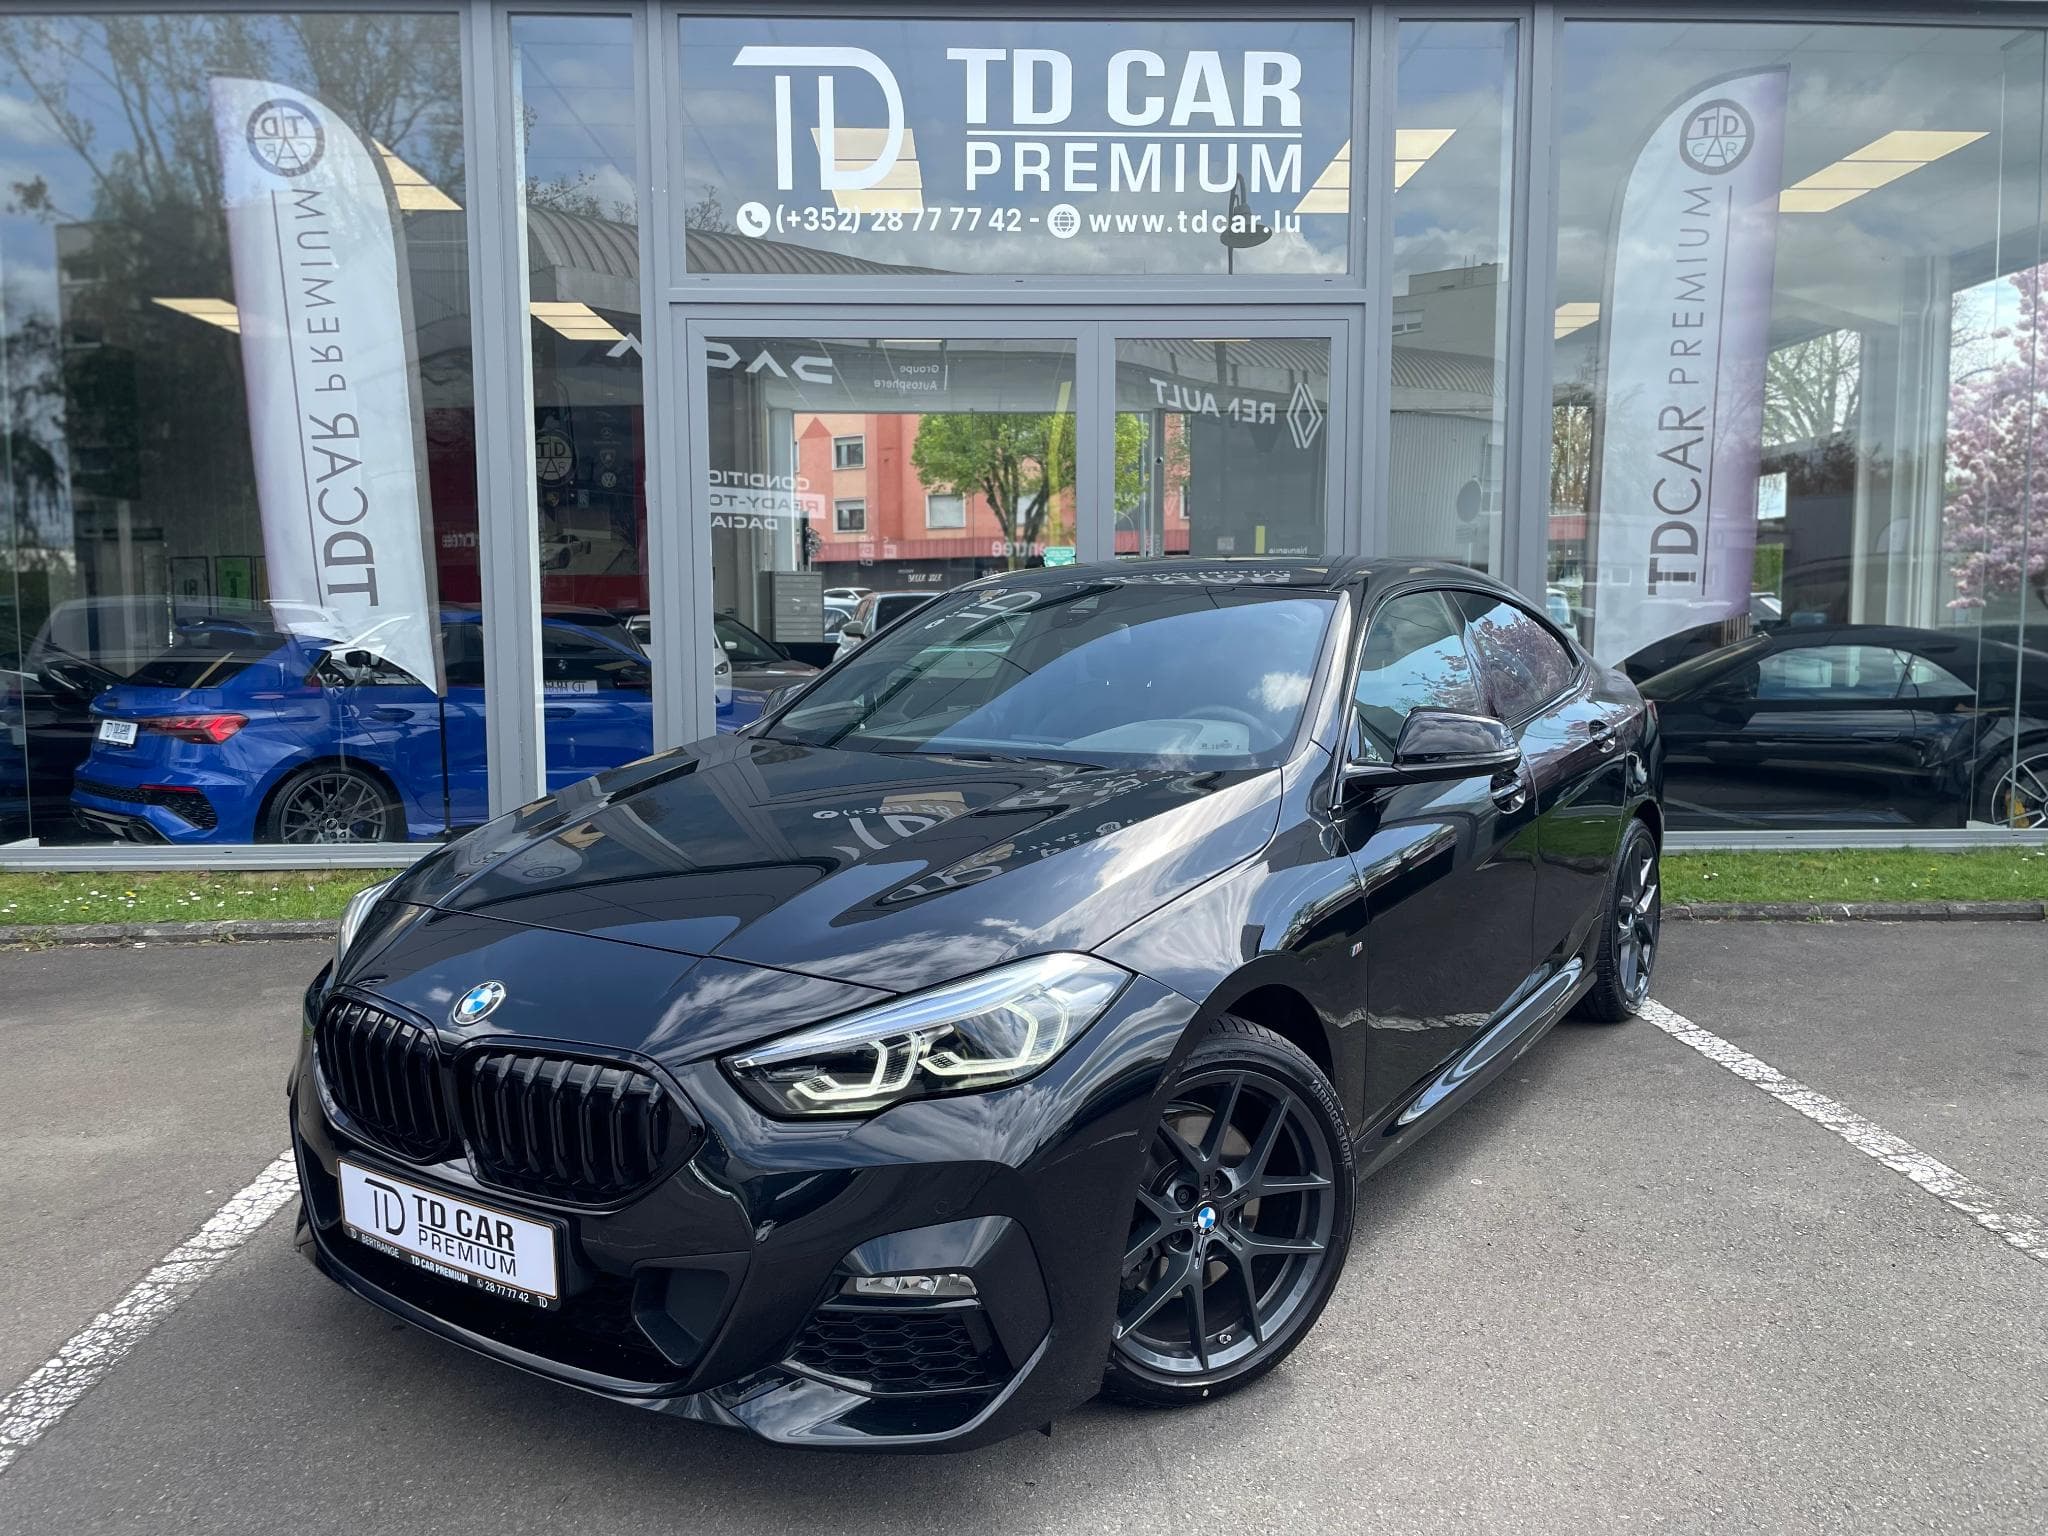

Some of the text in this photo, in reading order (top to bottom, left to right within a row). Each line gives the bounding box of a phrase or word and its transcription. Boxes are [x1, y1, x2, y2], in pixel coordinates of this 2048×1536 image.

[946, 47, 1303, 127] TD CAR
[966, 141, 1303, 194] PREMIUM
[776, 204, 862, 234] (+352)
[871, 207, 904, 232] 28
[911, 207, 943, 232] 77
[951, 207, 983, 232] 77
[988, 207, 1023, 232] 42
[1088, 209, 1301, 234] www.tdcar.lu
[1647, 186, 1713, 596] TDCAR PREMIUM
[412, 1193, 516, 1253] TD CAR
[418, 1228, 517, 1278] PREMIUM
[361, 1233, 400, 1259] BERTRANGE
[410, 1255, 420, 1267] TD
[421, 1258, 435, 1272] CAR
[435, 1262, 469, 1284] PREMIUM
[485, 1281, 496, 1293] 28
[496, 1283, 506, 1296] 77
[507, 1287, 518, 1299] 77
[518, 1292, 530, 1303] 42
